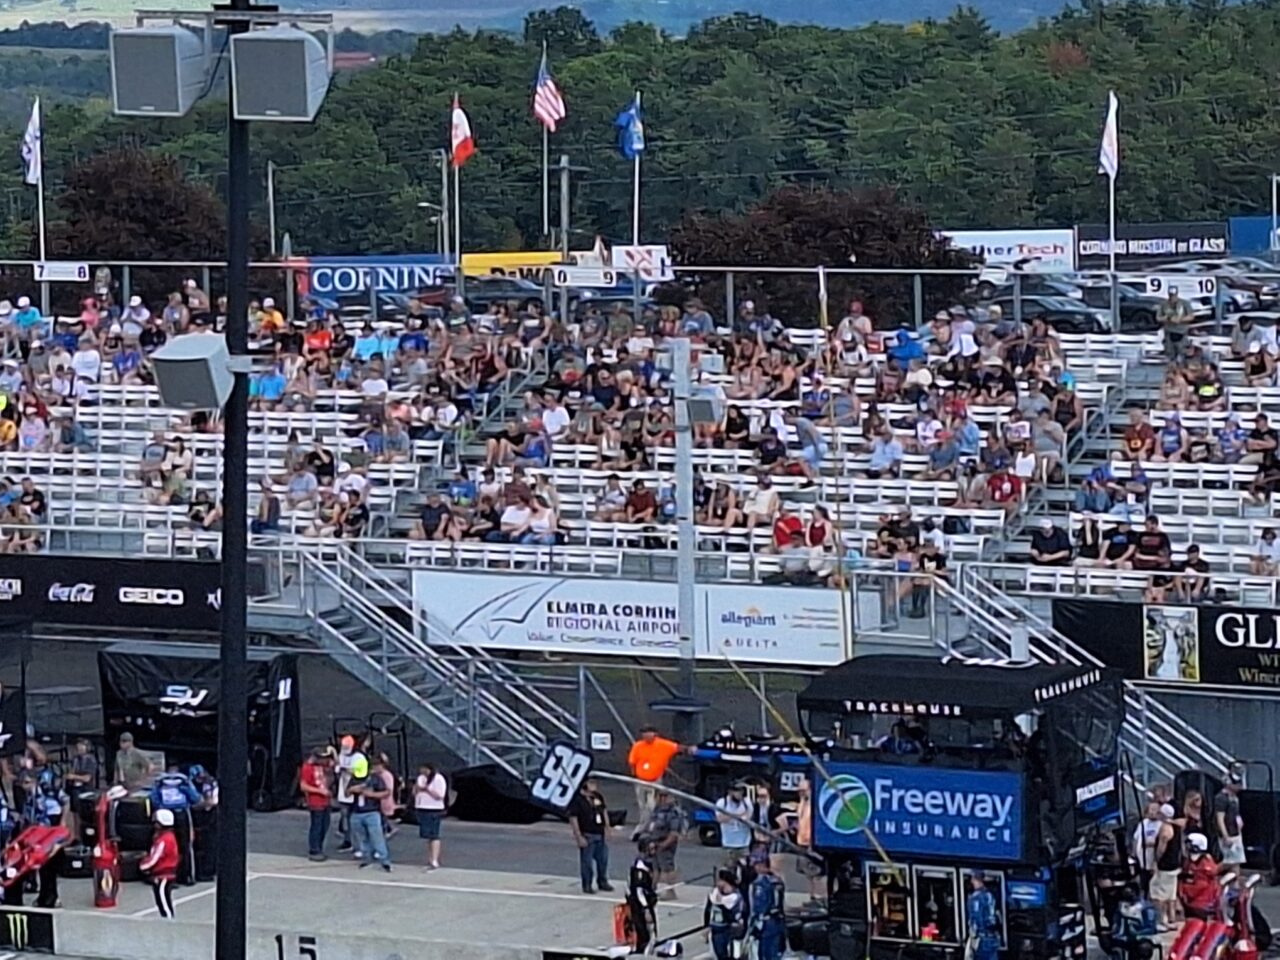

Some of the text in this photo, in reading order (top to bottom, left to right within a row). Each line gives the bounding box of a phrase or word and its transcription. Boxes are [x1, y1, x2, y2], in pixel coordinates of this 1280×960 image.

[37, 264, 45, 278] 7
[602, 270, 614, 285] 9
[1149, 277, 1215, 294] 9 10
[119, 587, 184, 605] GEICO
[546, 601, 677, 620] ELMIRA CORNIN
[546, 616, 622, 632] REGIONAL
[721, 611, 777, 628] allegiant
[873, 778, 1014, 827] Freeway
[873, 819, 1012, 842] INSURANCE
